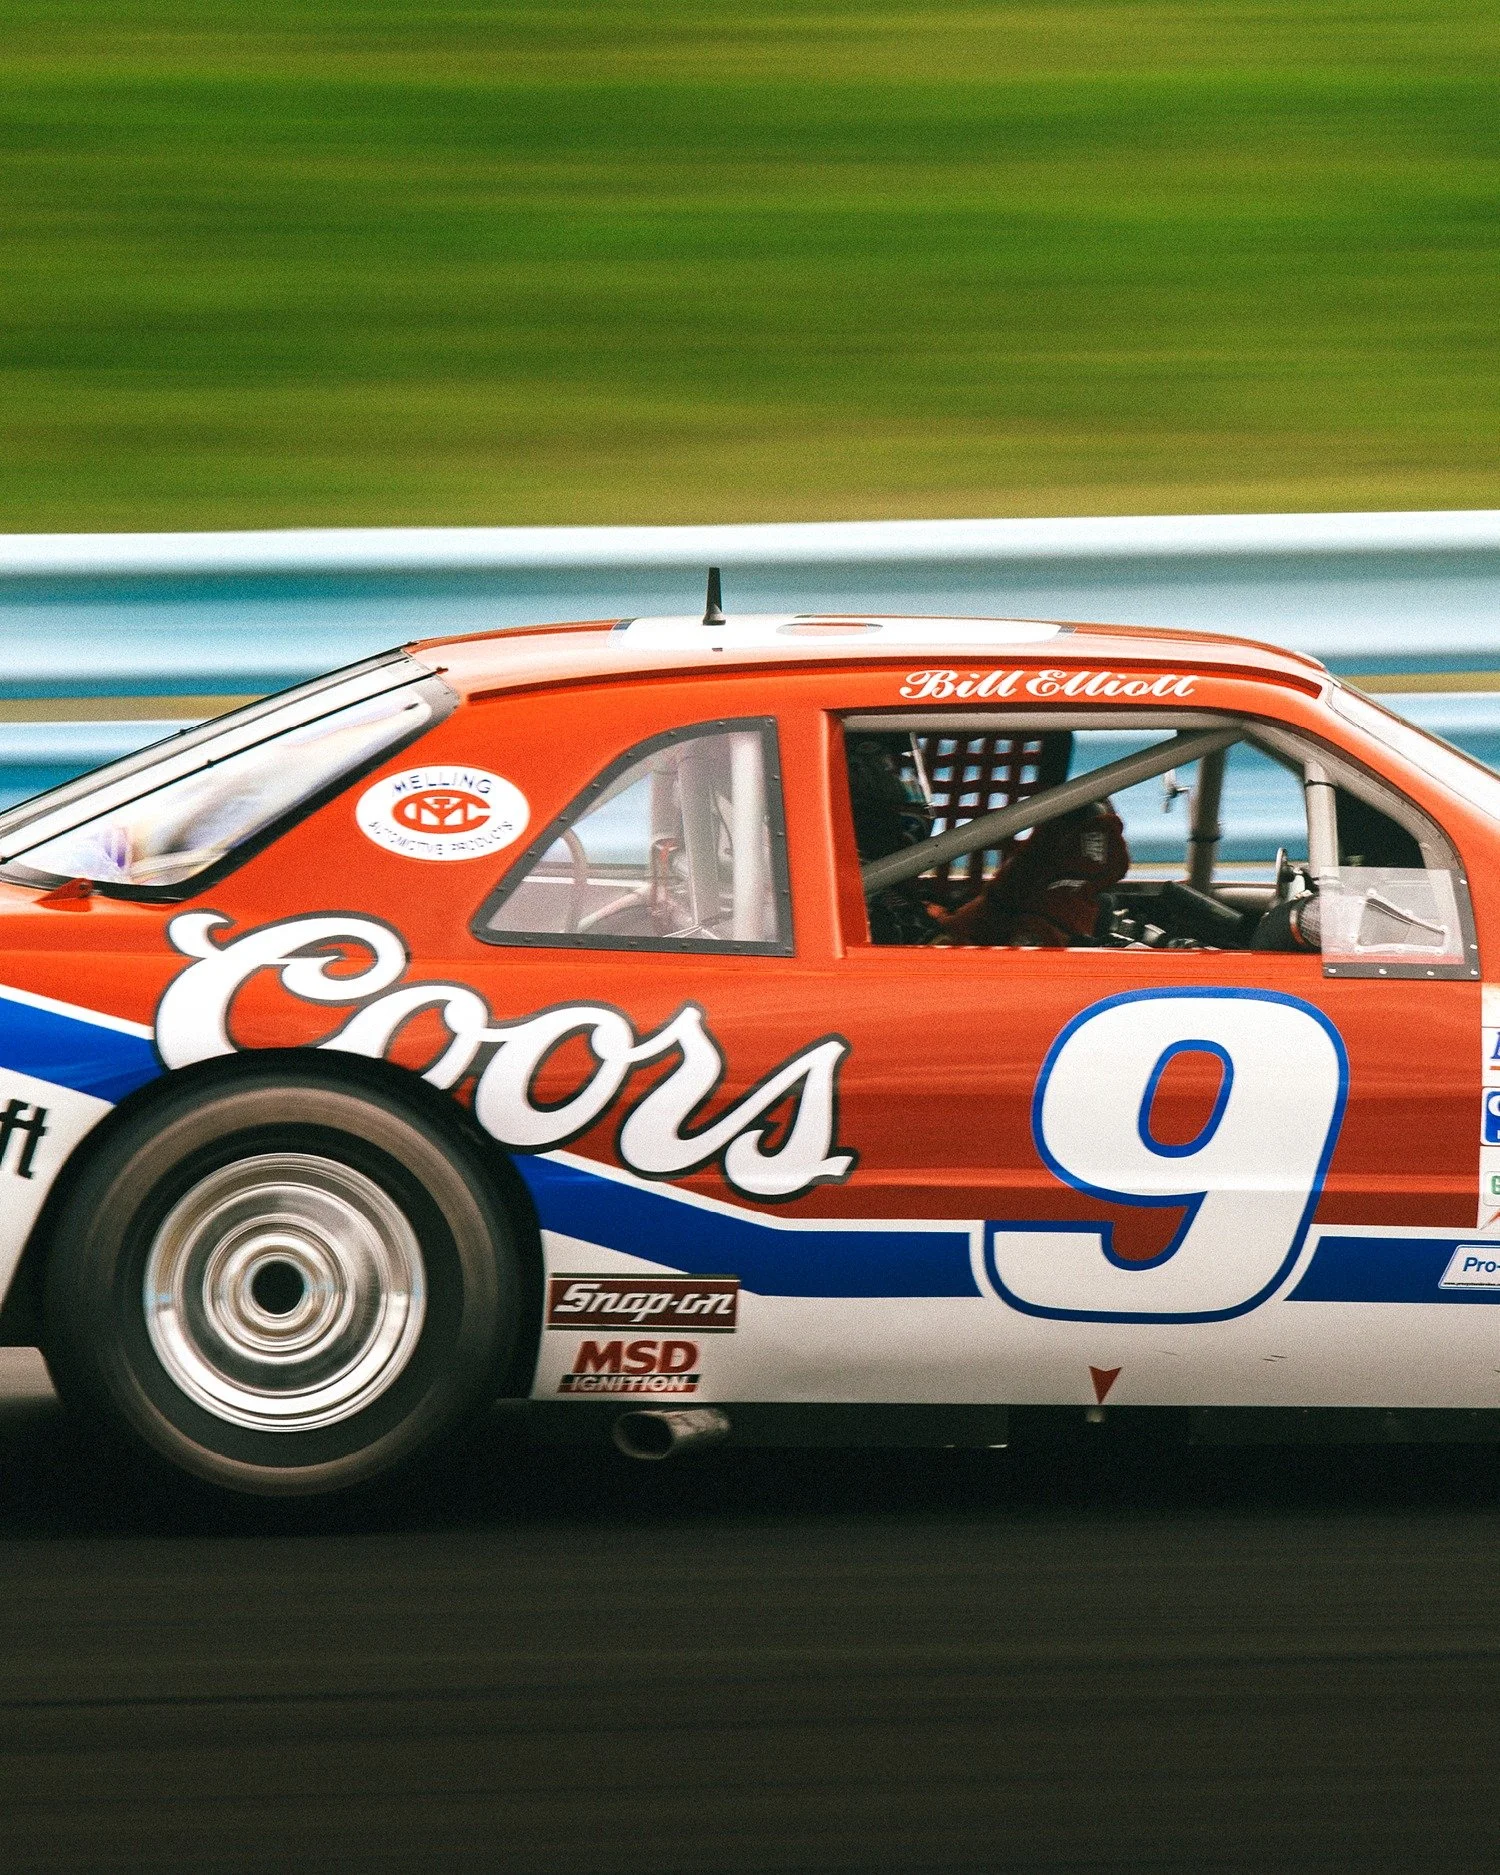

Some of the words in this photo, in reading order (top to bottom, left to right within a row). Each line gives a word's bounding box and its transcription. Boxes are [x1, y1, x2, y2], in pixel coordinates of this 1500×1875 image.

[899, 669, 1025, 699] Bill
[1025, 669, 1199, 698] Elliott
[391, 773, 492, 797] MELLING
[153, 908, 857, 1200] Coors
[984, 985, 1350, 1325] 9
[553, 1283, 734, 1323] Snap-on
[573, 1340, 699, 1374] MSD
[570, 1376, 689, 1392] IGNITION
